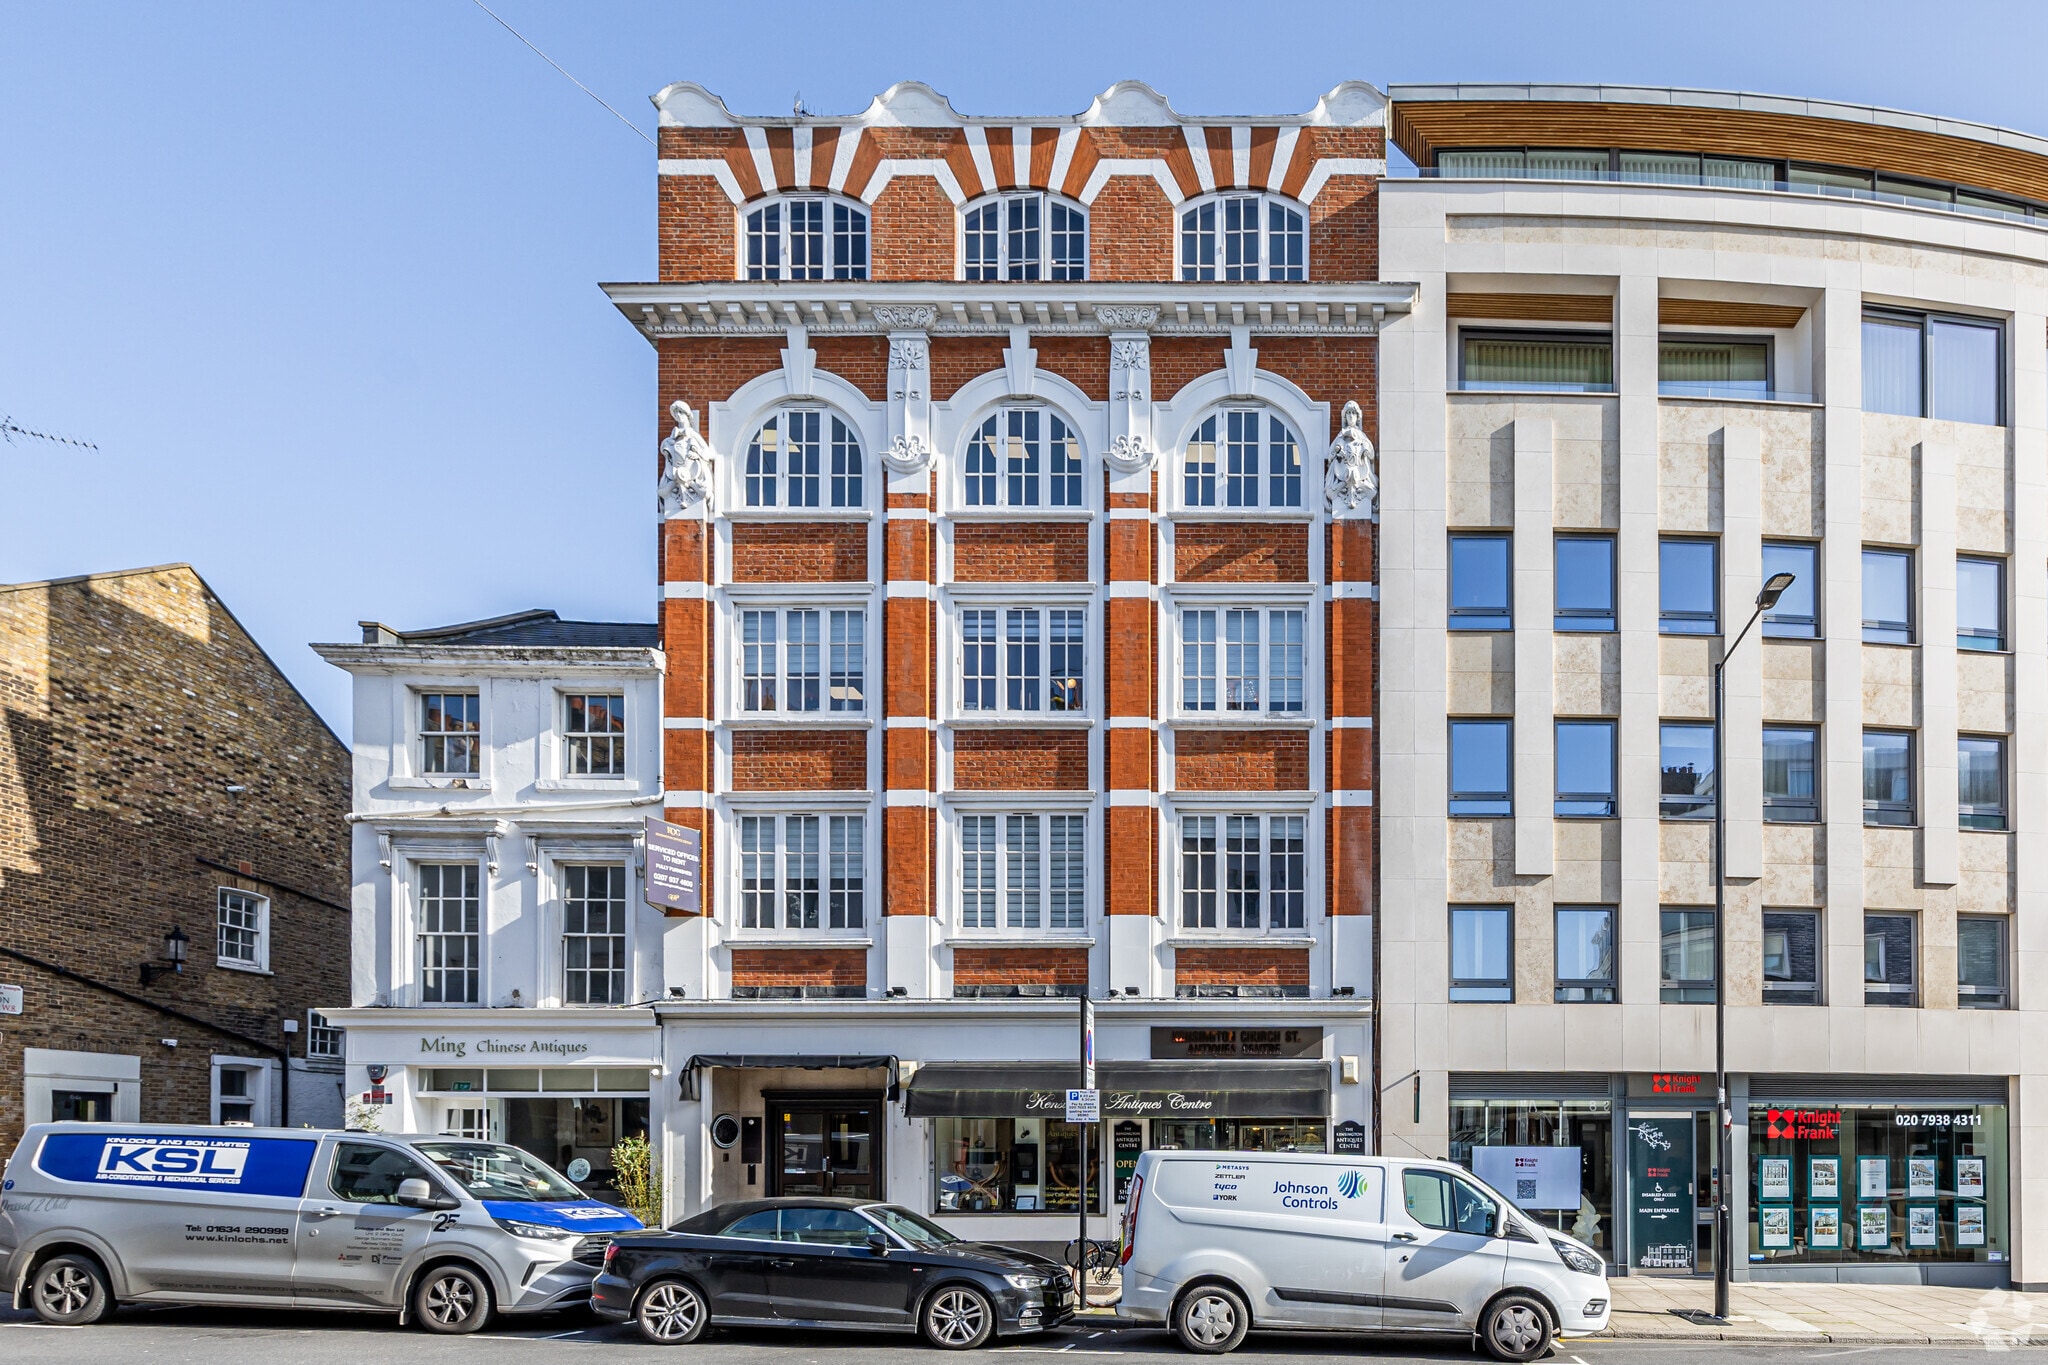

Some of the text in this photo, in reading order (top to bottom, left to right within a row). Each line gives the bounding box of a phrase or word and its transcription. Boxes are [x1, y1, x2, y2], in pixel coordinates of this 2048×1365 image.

[648, 844, 699, 861] SERVICED OFFICES
[656, 863, 669, 871] FULLY
[672, 857, 686, 866] RENT
[1171, 1030, 1236, 1043] KENSINGTON
[1240, 1030, 1281, 1043] CHURCH
[421, 1036, 588, 1057] Ming Chinese Antiques
[1187, 1043, 1282, 1055] ANTIQUES CENTRE
[1672, 1073, 1701, 1085] Knight
[1671, 1084, 1697, 1093] Frank
[1104, 1093, 1162, 1114] Antiques
[1167, 1093, 1212, 1109] Centre
[1797, 1111, 1842, 1127] Knight
[1896, 1115, 1982, 1126] 020 7938 4311
[1797, 1126, 1835, 1139] Frank
[106, 1137, 157, 1146] KINLOCHS
[210, 1141, 250, 1149] LIMITED
[105, 1146, 238, 1174] KSL
[95, 1173, 157, 1182] AIR-CONDITIONING
[164, 1175, 207, 1184] MECHANICAL
[208, 1177, 241, 1185] SERVICES
[1214, 1183, 1237, 1191] tyco
[1273, 1181, 1328, 1194] Johnson
[1282, 1195, 1338, 1210] Controls
[185, 1224, 289, 1235] Tel: 01634 290999
[185, 1234, 289, 1245] www.kinlochs.net
